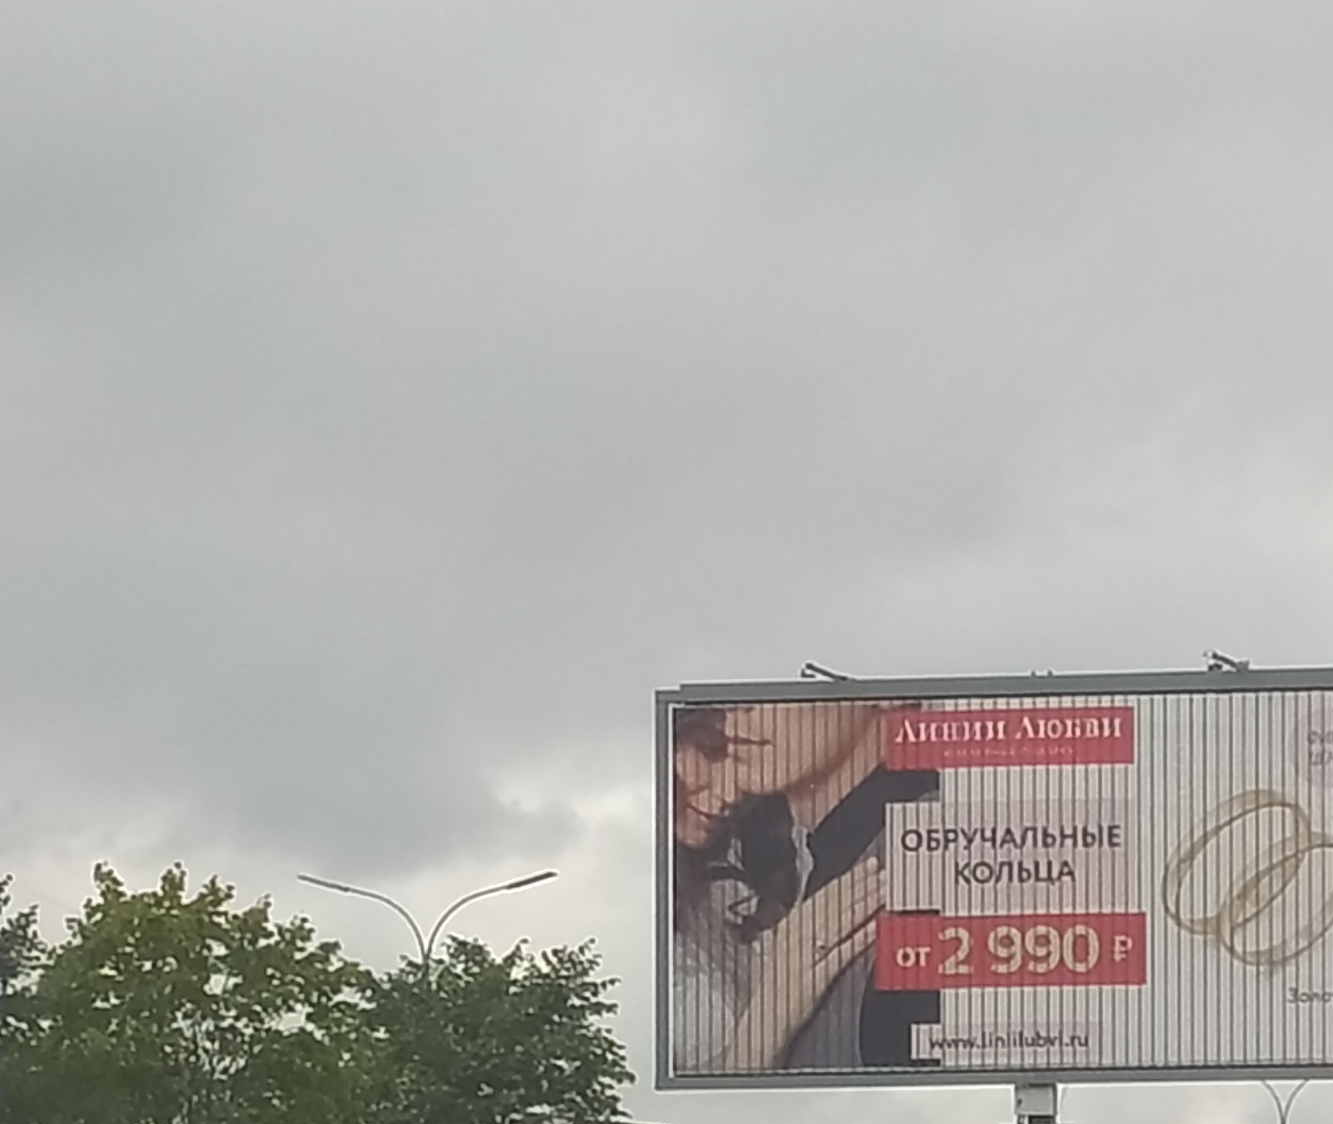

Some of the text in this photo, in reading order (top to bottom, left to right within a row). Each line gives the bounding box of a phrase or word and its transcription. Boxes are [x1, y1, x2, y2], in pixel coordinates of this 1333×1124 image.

[901, 824, 1122, 852] ОБРУЧАЛЬНЫЕ
[954, 860, 1076, 886] КОЛЬЦА
[938, 926, 973, 974] 2
[987, 924, 1099, 974] 990
